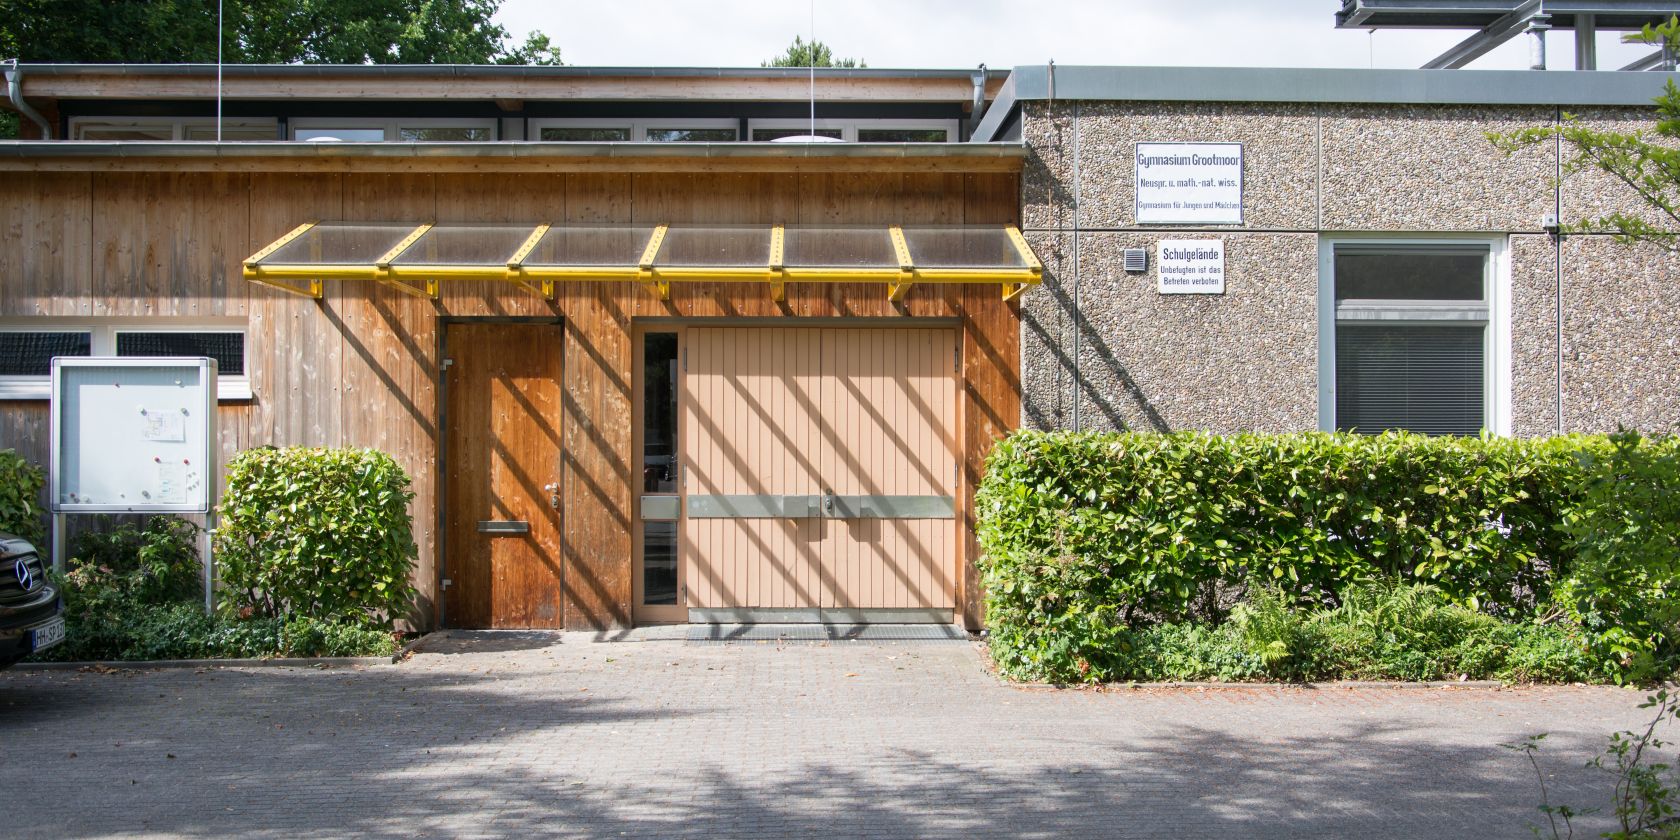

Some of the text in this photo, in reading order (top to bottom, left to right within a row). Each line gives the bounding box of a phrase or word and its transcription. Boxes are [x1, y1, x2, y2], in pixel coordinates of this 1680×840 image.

[1138, 153, 1239, 168] Gymnasium Grootmoor
[1140, 178, 1167, 190] Neuspr.
[1169, 179, 1175, 187] u.
[1218, 178, 1238, 187] wiss.
[1138, 200, 1240, 210] Gymnasium für Jungen und Mädchen
[1163, 247, 1219, 262] Schulgelände
[1160, 266, 1221, 275] Unbefugten ist das
[1163, 277, 1219, 285] Betreten verboten
